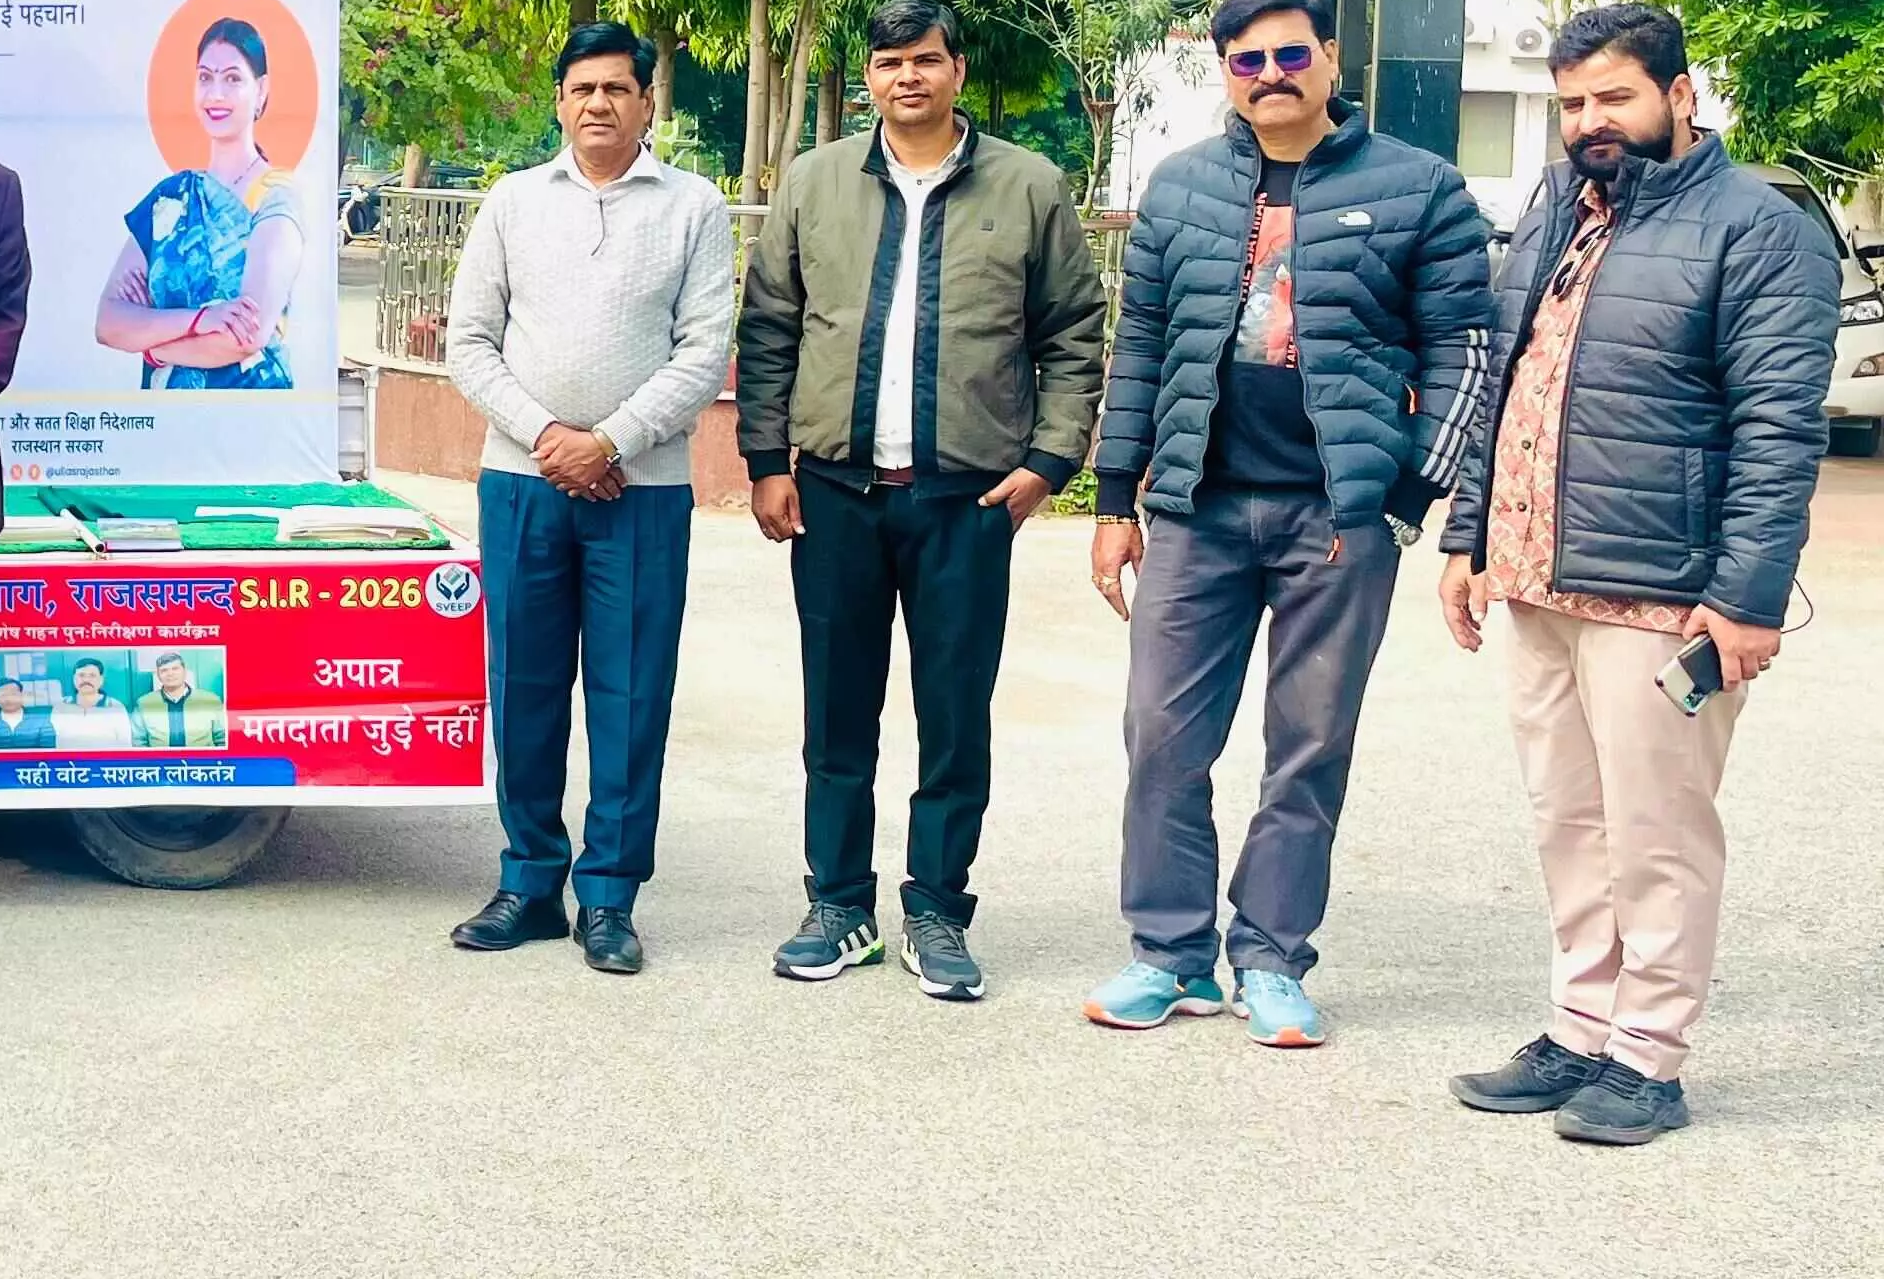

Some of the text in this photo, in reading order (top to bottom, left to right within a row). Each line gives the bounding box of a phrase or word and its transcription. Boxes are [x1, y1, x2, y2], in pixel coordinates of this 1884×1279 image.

[9, 413, 30, 431] और
[34, 417, 61, 431] सतत
[65, 412, 96, 431] शिक्षा
[100, 412, 155, 431] निदेशालय
[12, 439, 104, 453] राजस्थान सरकार
[68, 578, 237, 616] राजसमन्द
[239, 577, 310, 609] S.I.R
[339, 577, 422, 608] 2026
[436, 602, 472, 612] SVEEP
[25, 625, 58, 640] गहन
[313, 658, 404, 688] अपात्र
[237, 715, 352, 748] मतदाता
[422, 704, 480, 748] नहीं
[15, 762, 51, 787] सही
[164, 760, 236, 783] लोकतंत्र
